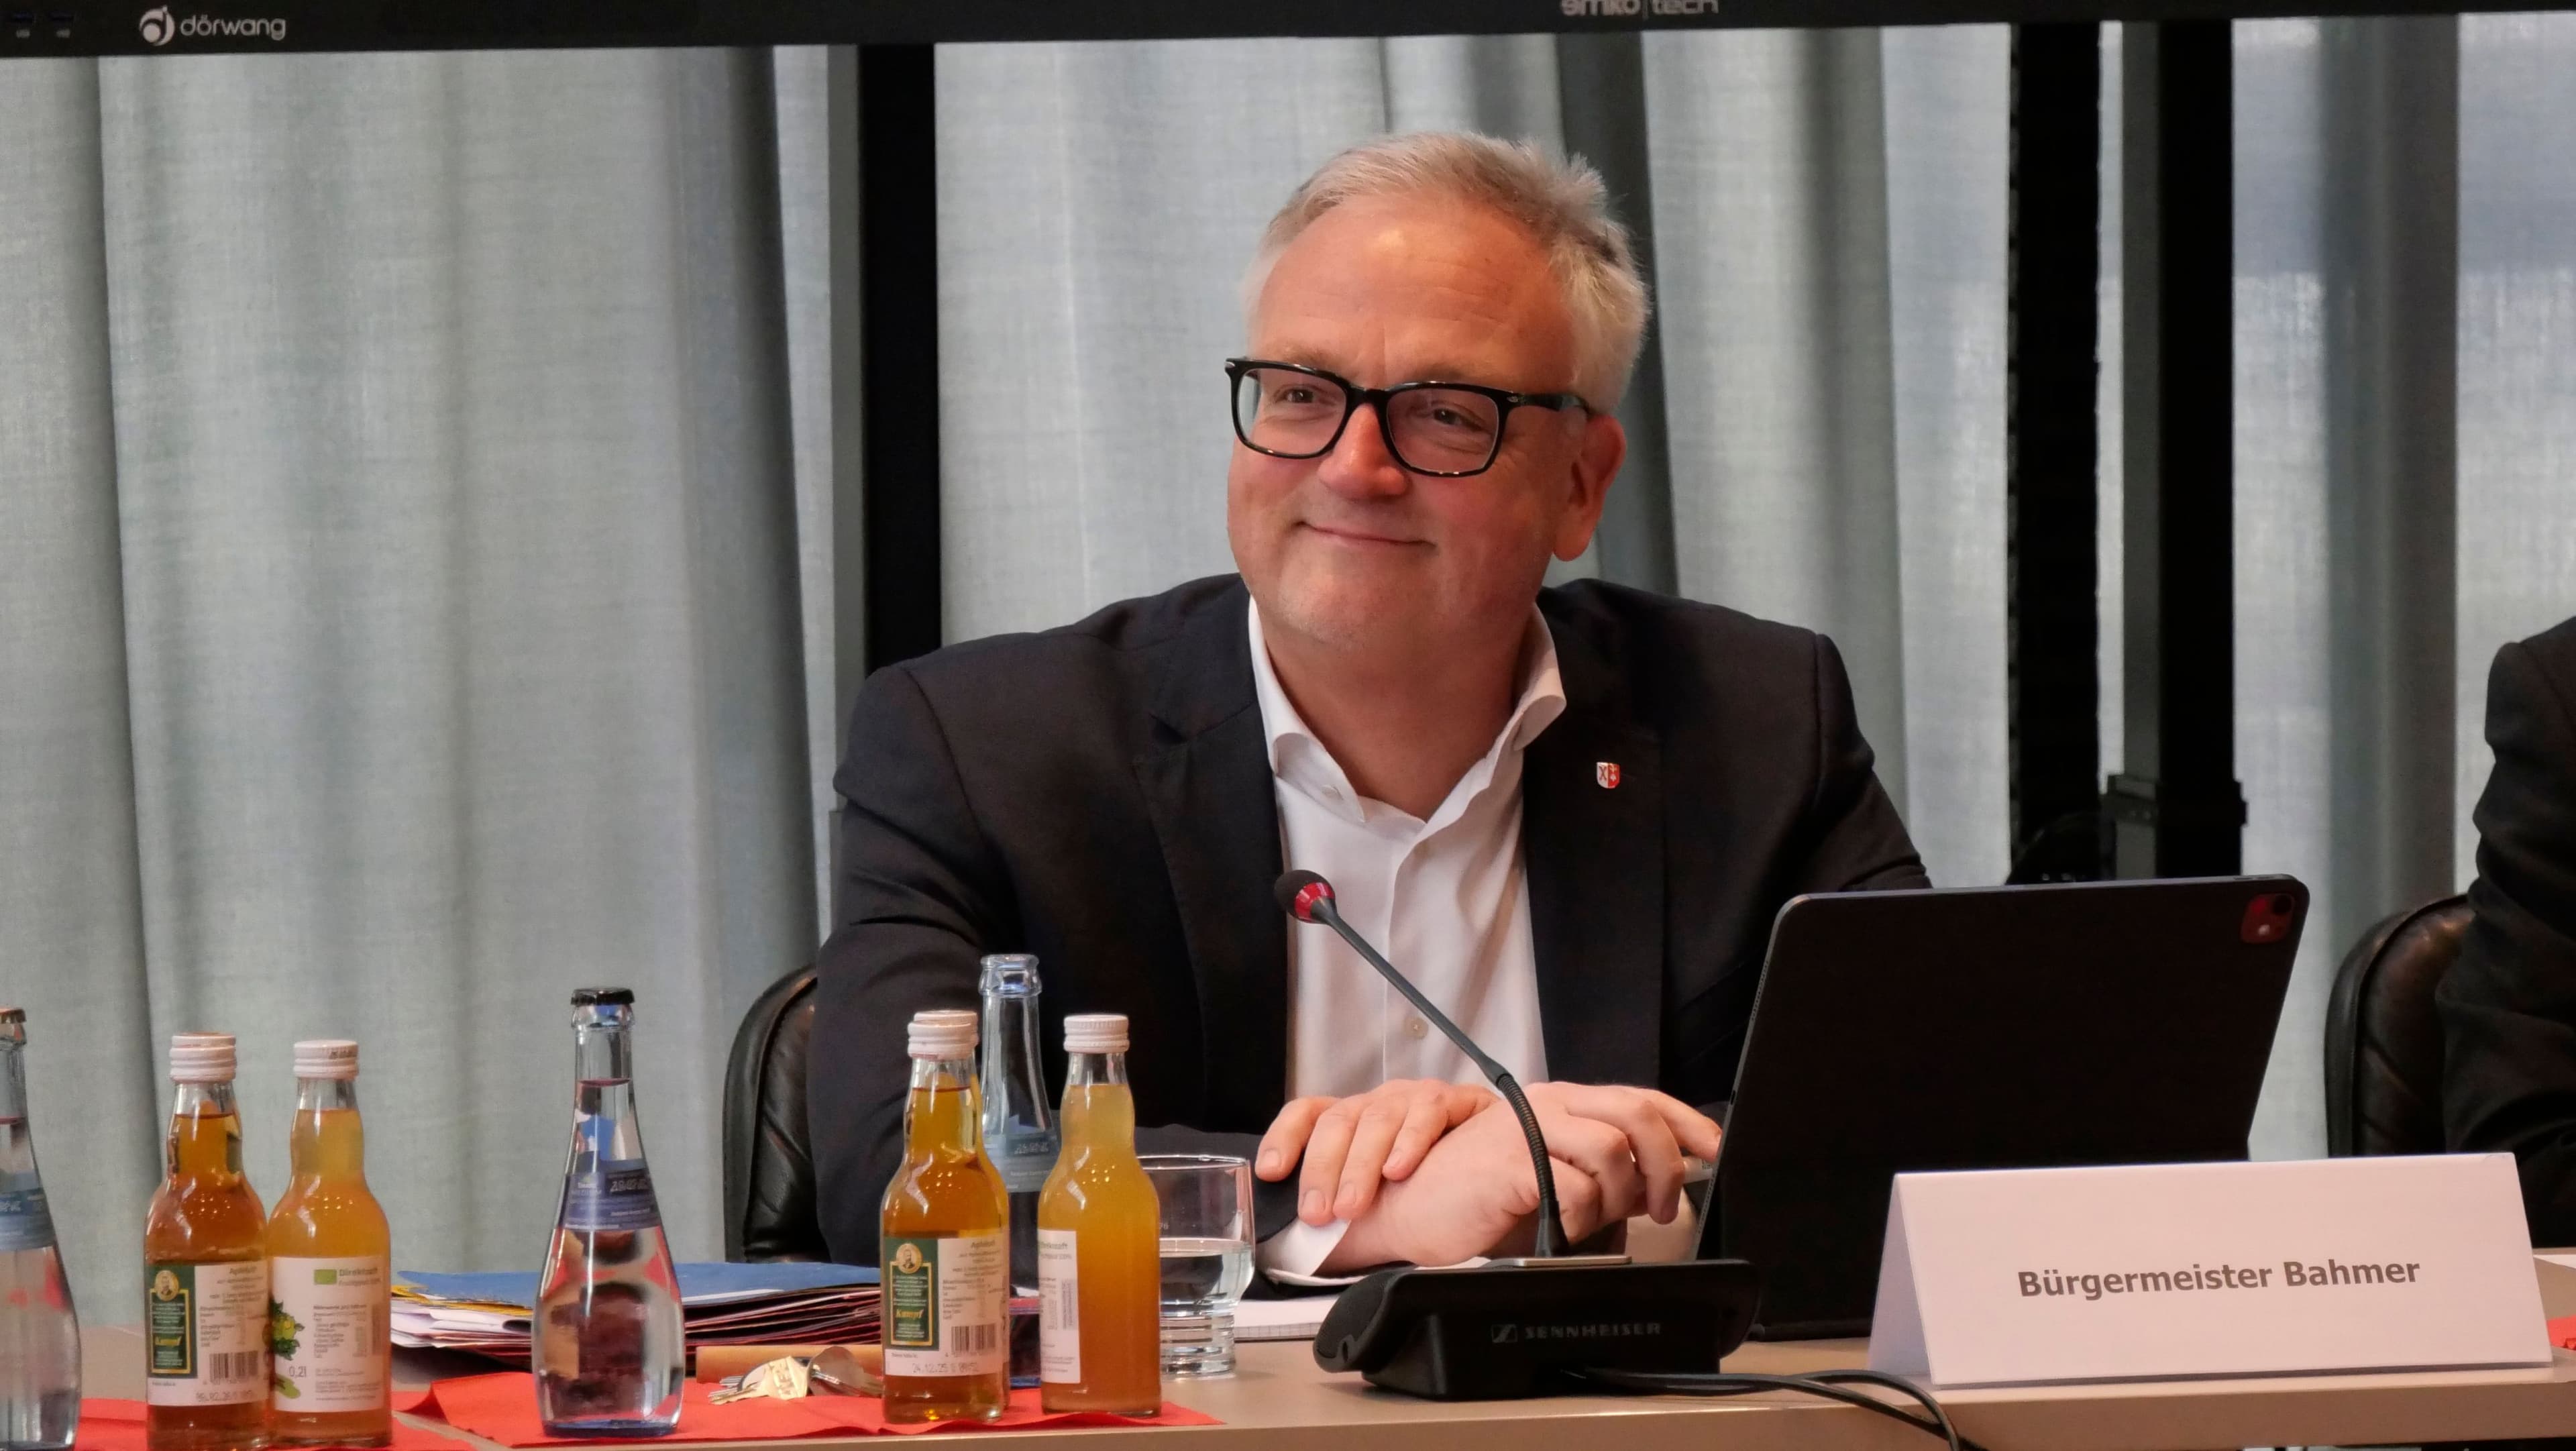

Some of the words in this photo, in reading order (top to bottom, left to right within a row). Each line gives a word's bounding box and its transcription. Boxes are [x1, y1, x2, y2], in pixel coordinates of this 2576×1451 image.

[180, 14, 286, 42] dörwang
[2018, 1264, 2273, 1301] Bürgermeister
[2283, 1258, 2420, 1287] Bahmer
[1524, 1322, 1661, 1340] SENNHEISER
